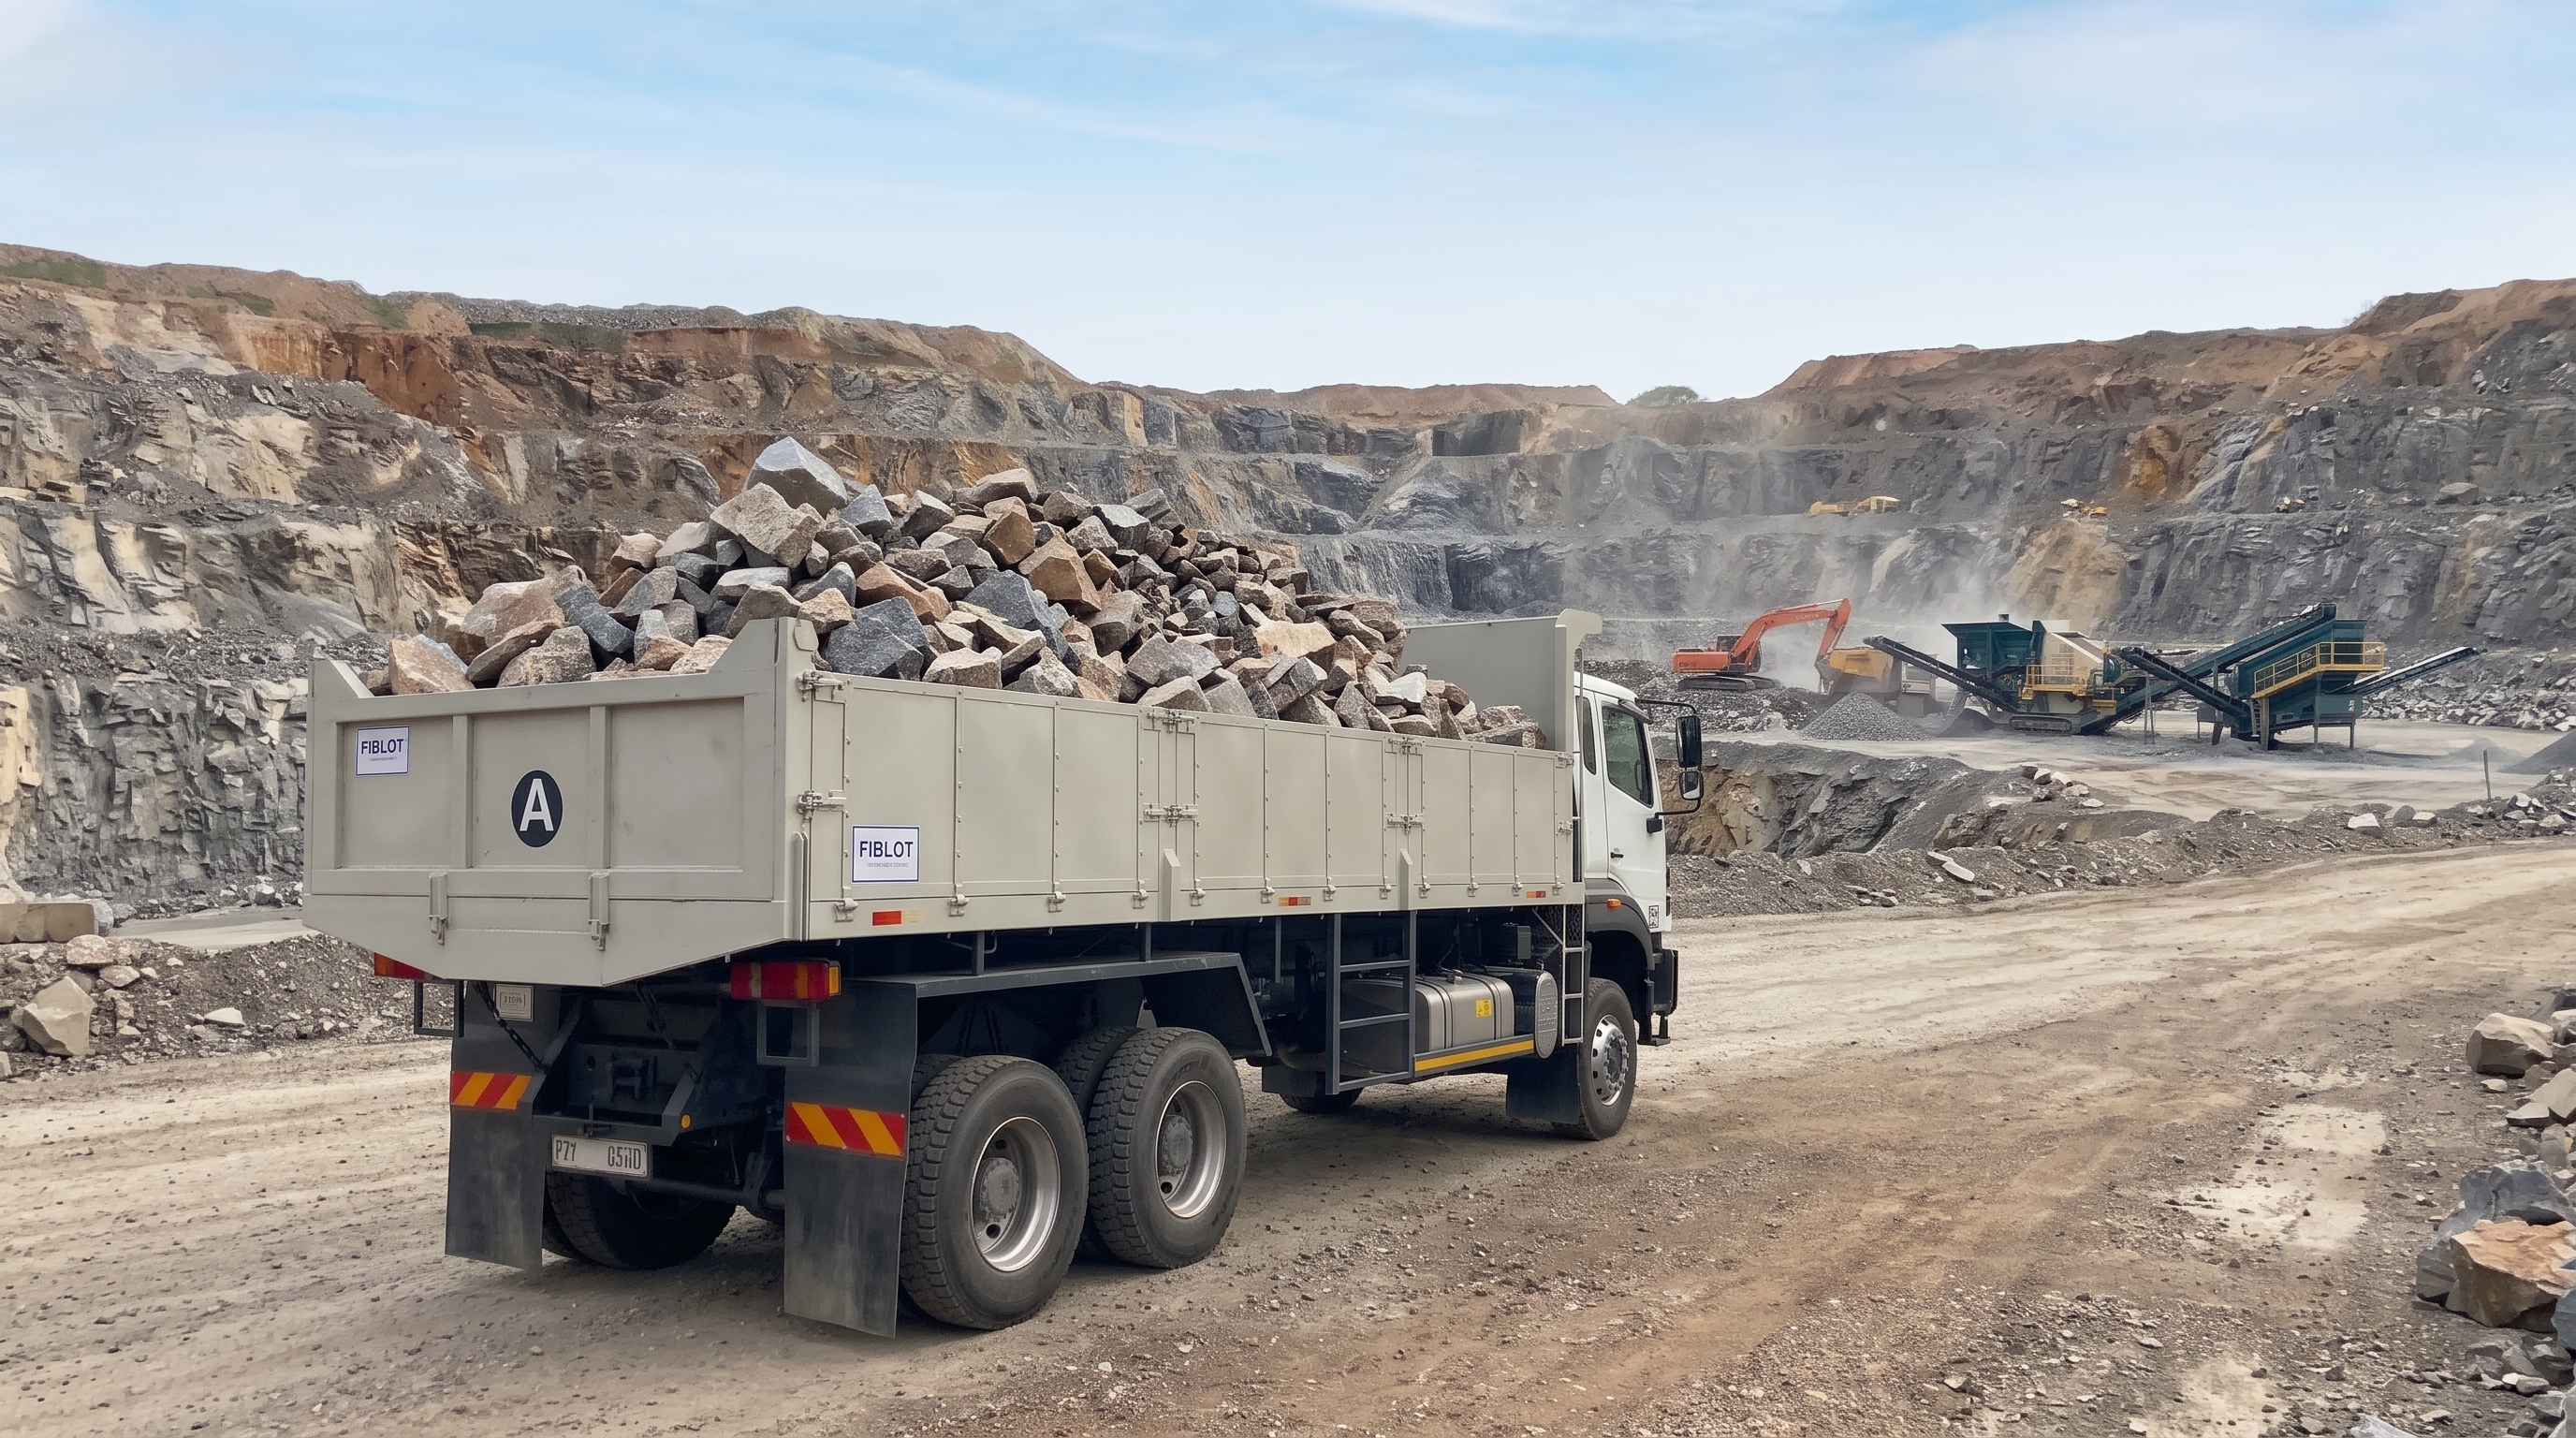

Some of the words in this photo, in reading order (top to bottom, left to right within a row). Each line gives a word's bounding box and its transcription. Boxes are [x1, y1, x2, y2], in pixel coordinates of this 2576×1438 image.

[361, 739, 404, 755] FIBLOT
[520, 778, 554, 831] A
[859, 841, 914, 858] FIBLOT
